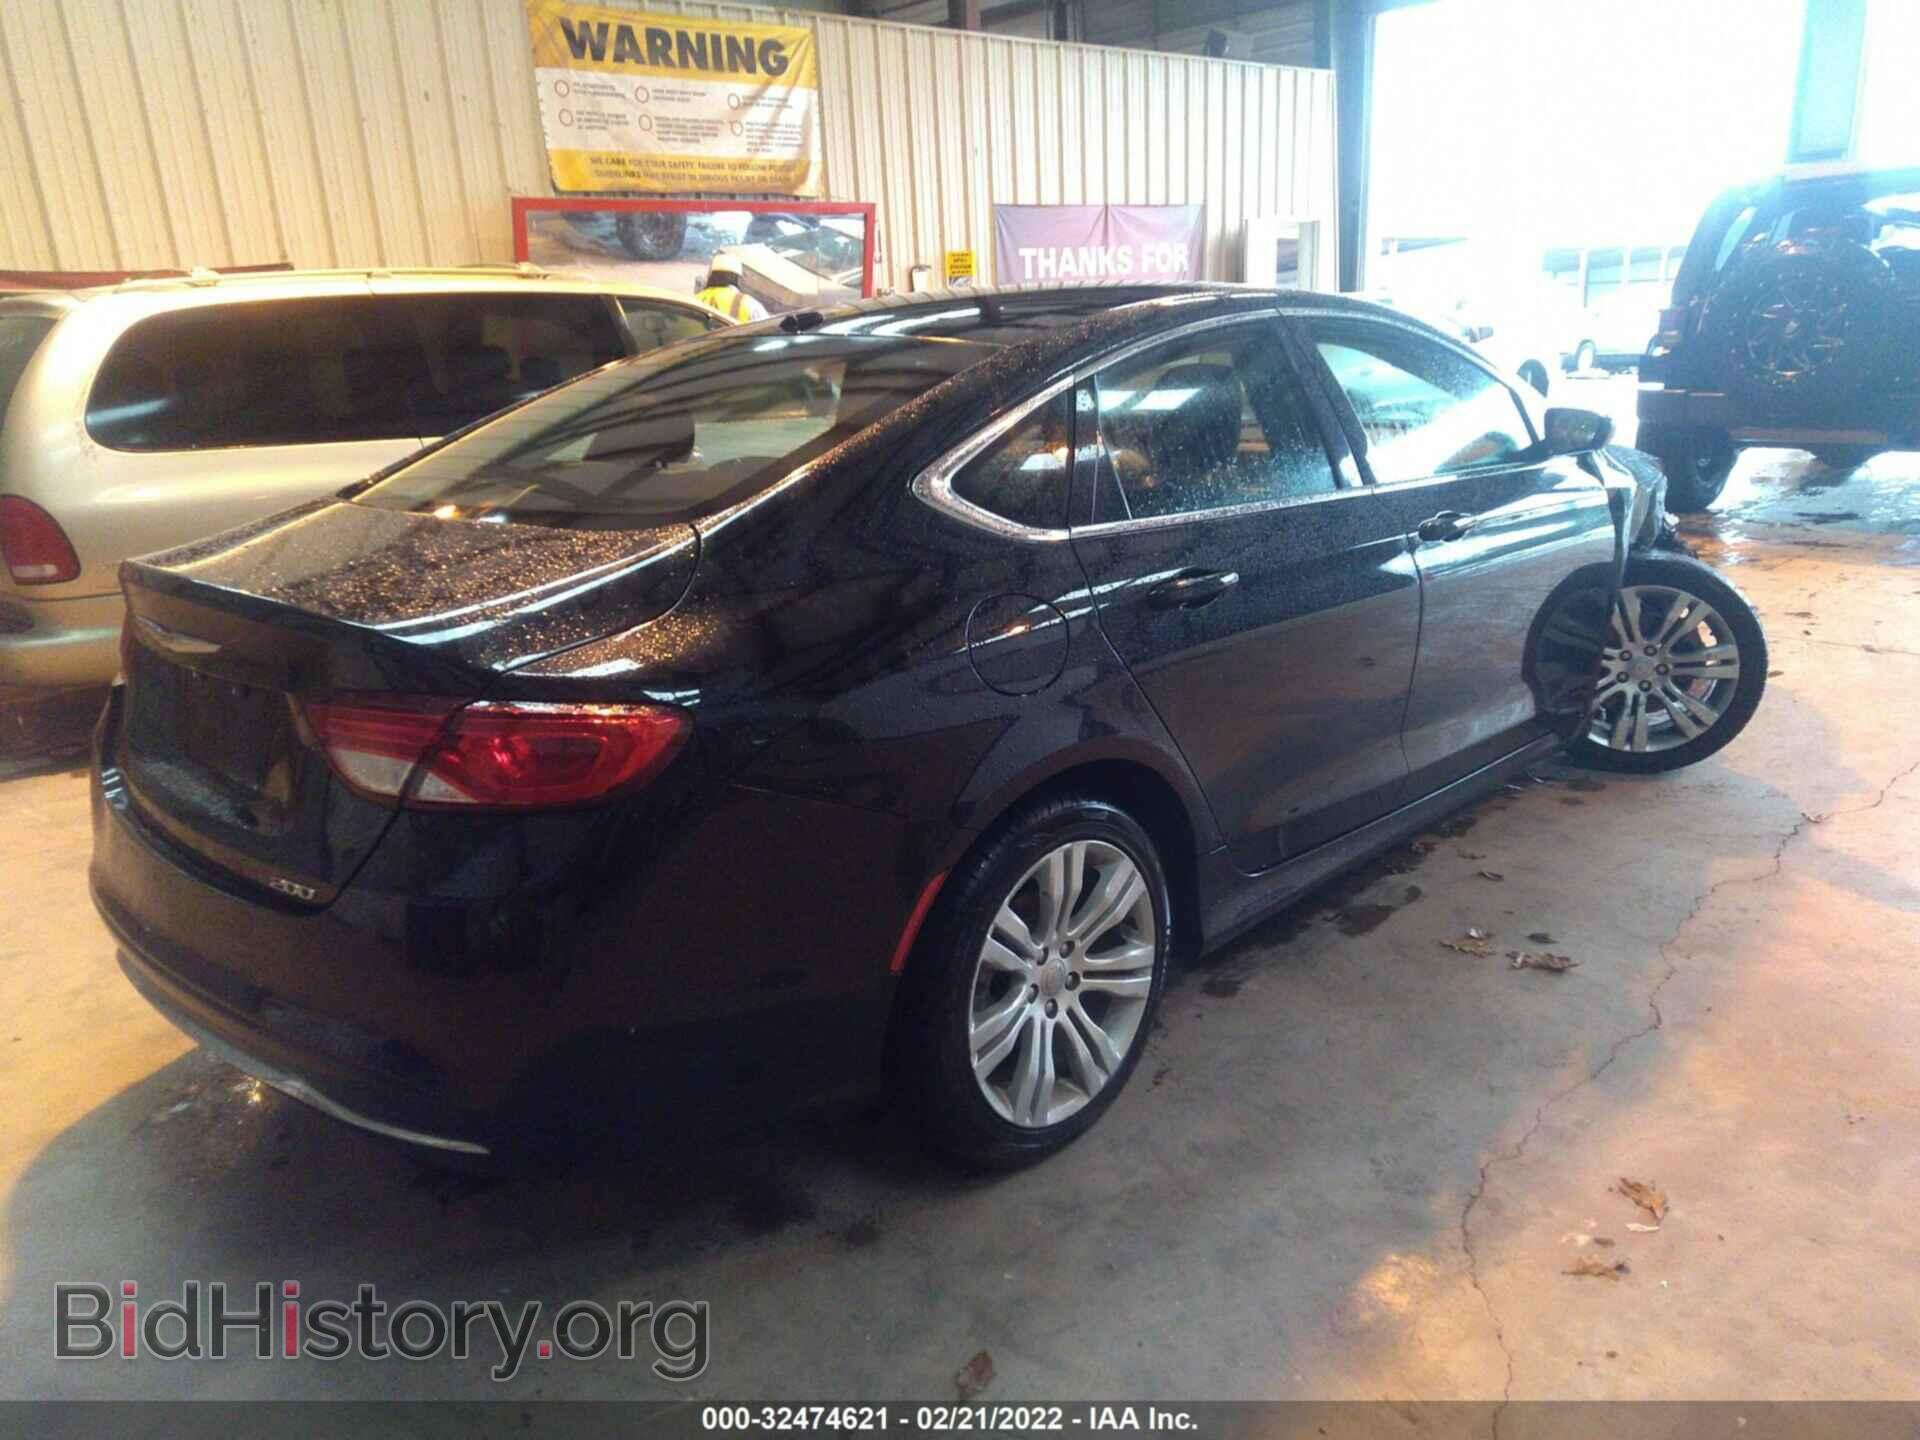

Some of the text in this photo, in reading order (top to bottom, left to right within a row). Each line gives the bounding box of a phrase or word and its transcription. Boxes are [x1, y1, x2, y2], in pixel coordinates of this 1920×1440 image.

[560, 17, 788, 76] WARNING
[1018, 242, 1188, 279] THANKS FOR
